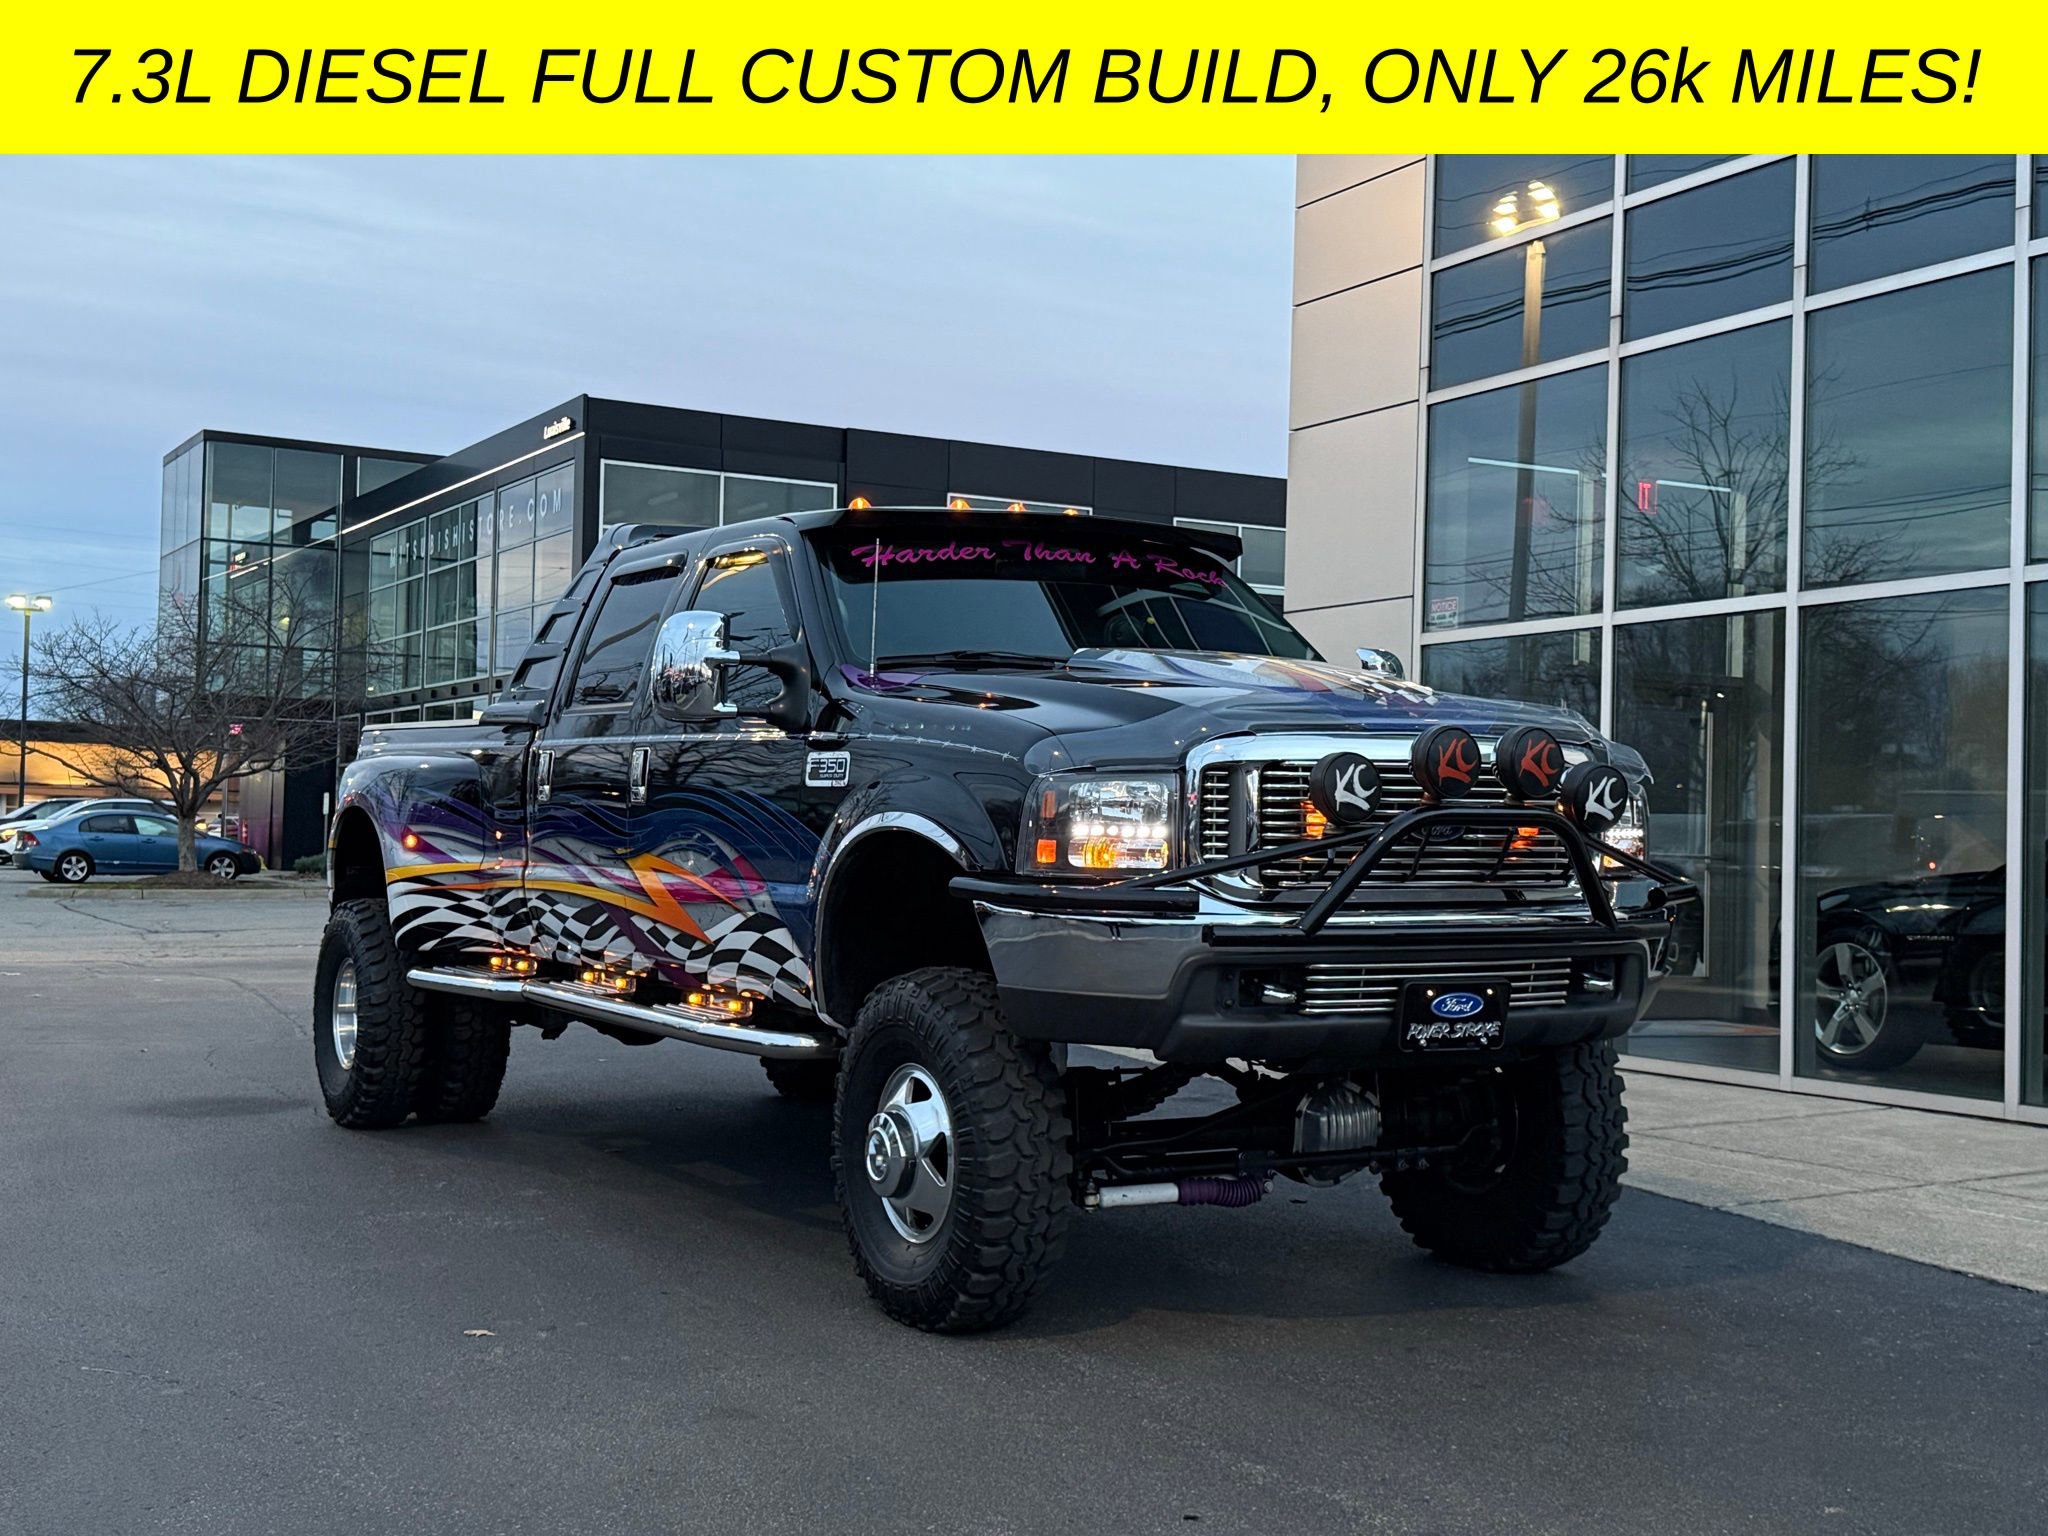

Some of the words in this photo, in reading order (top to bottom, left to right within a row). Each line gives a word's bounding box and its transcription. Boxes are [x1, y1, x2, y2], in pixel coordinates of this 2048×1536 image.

[850, 540, 997, 568] Harder
[1001, 538, 1097, 564] Than
[1109, 550, 1142, 569] A
[1147, 553, 1229, 588] Rock
[1334, 762, 1378, 812] KC
[1438, 738, 1478, 787] KC
[1519, 738, 1560, 788] KC
[1584, 776, 1624, 821] KC
[1440, 997, 1475, 1012] Ford
[1406, 1021, 1451, 1041] POWER
[1450, 1020, 1502, 1038] STROKE
